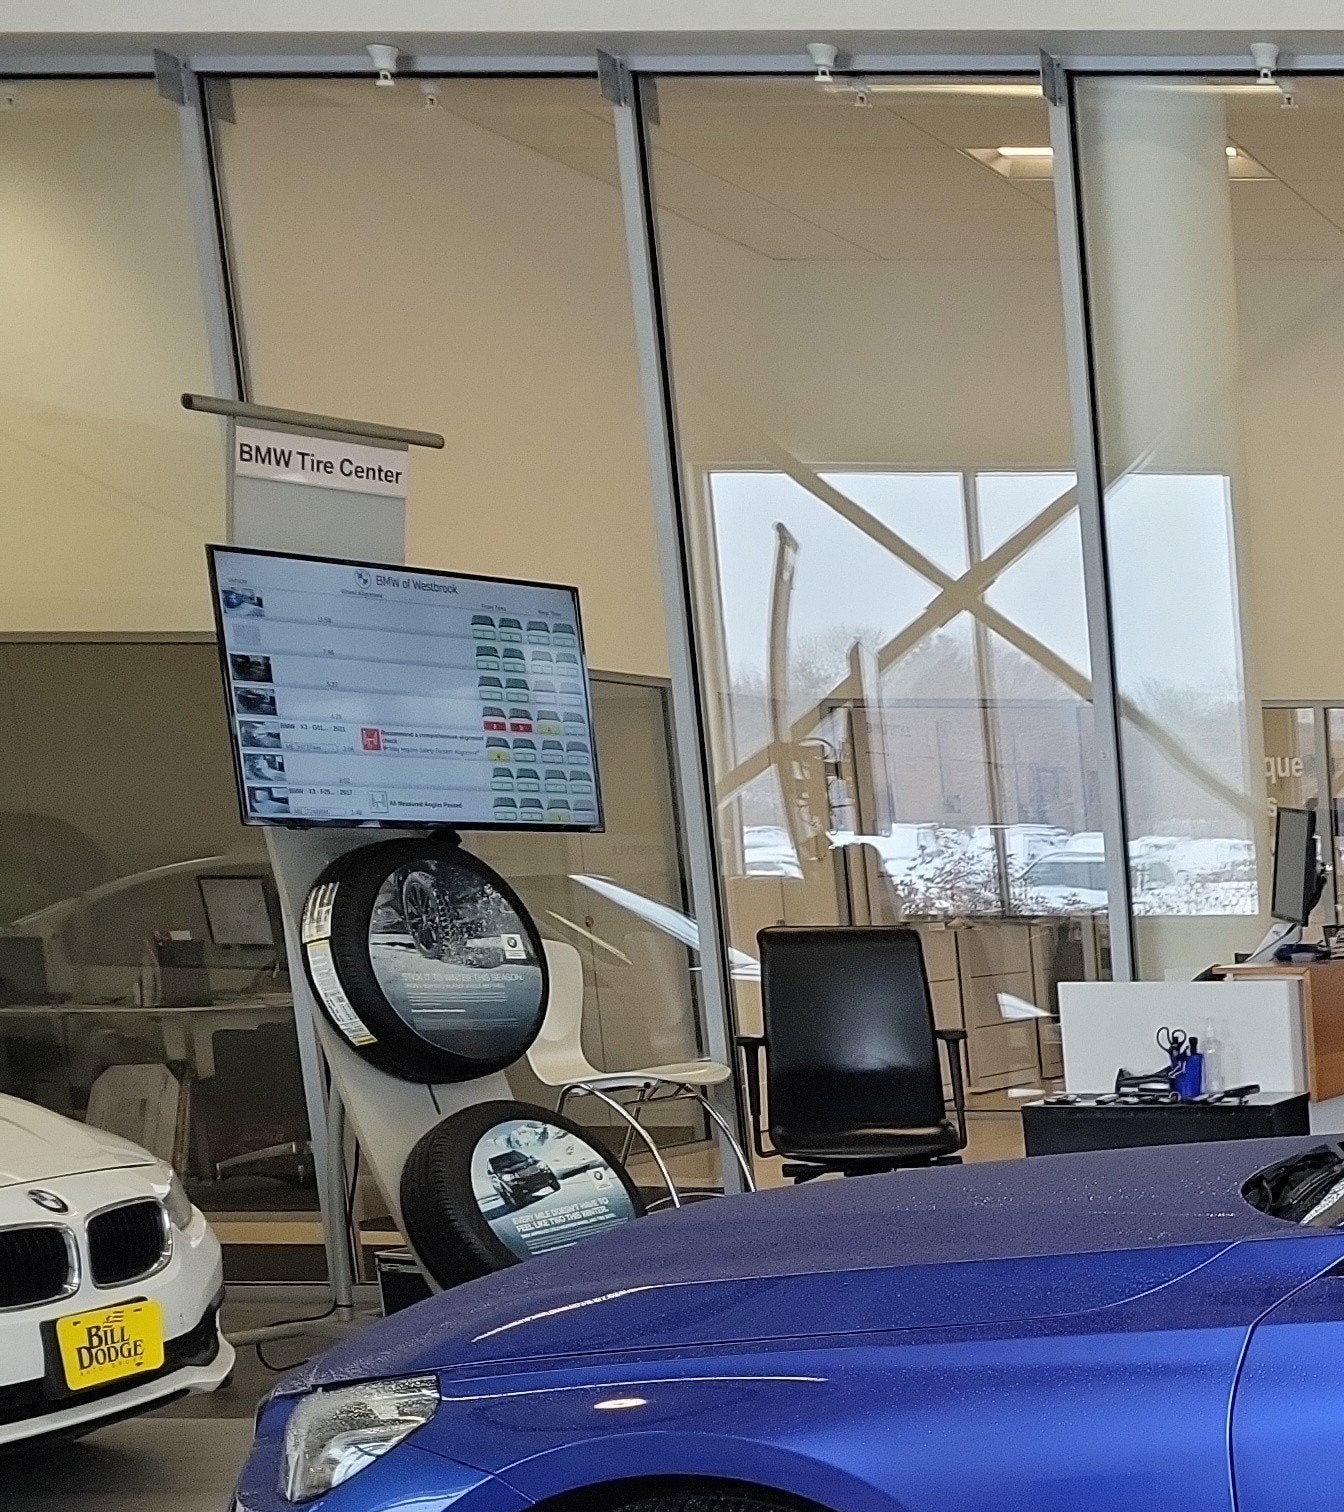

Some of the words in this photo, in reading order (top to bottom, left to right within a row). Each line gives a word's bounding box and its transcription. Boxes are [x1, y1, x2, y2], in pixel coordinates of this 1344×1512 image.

[239, 442, 292, 468] BMW
[296, 451, 334, 474] Tire
[339, 458, 402, 484] Center
[376, 575, 399, 588] BMW
[402, 579, 410, 589] of
[413, 580, 459, 594] Westbrook
[598, 1196, 609, 1206] TO
[565, 1211, 582, 1221] THIS
[86, 1325, 130, 1350] BILL
[75, 1339, 144, 1370] DODGE
